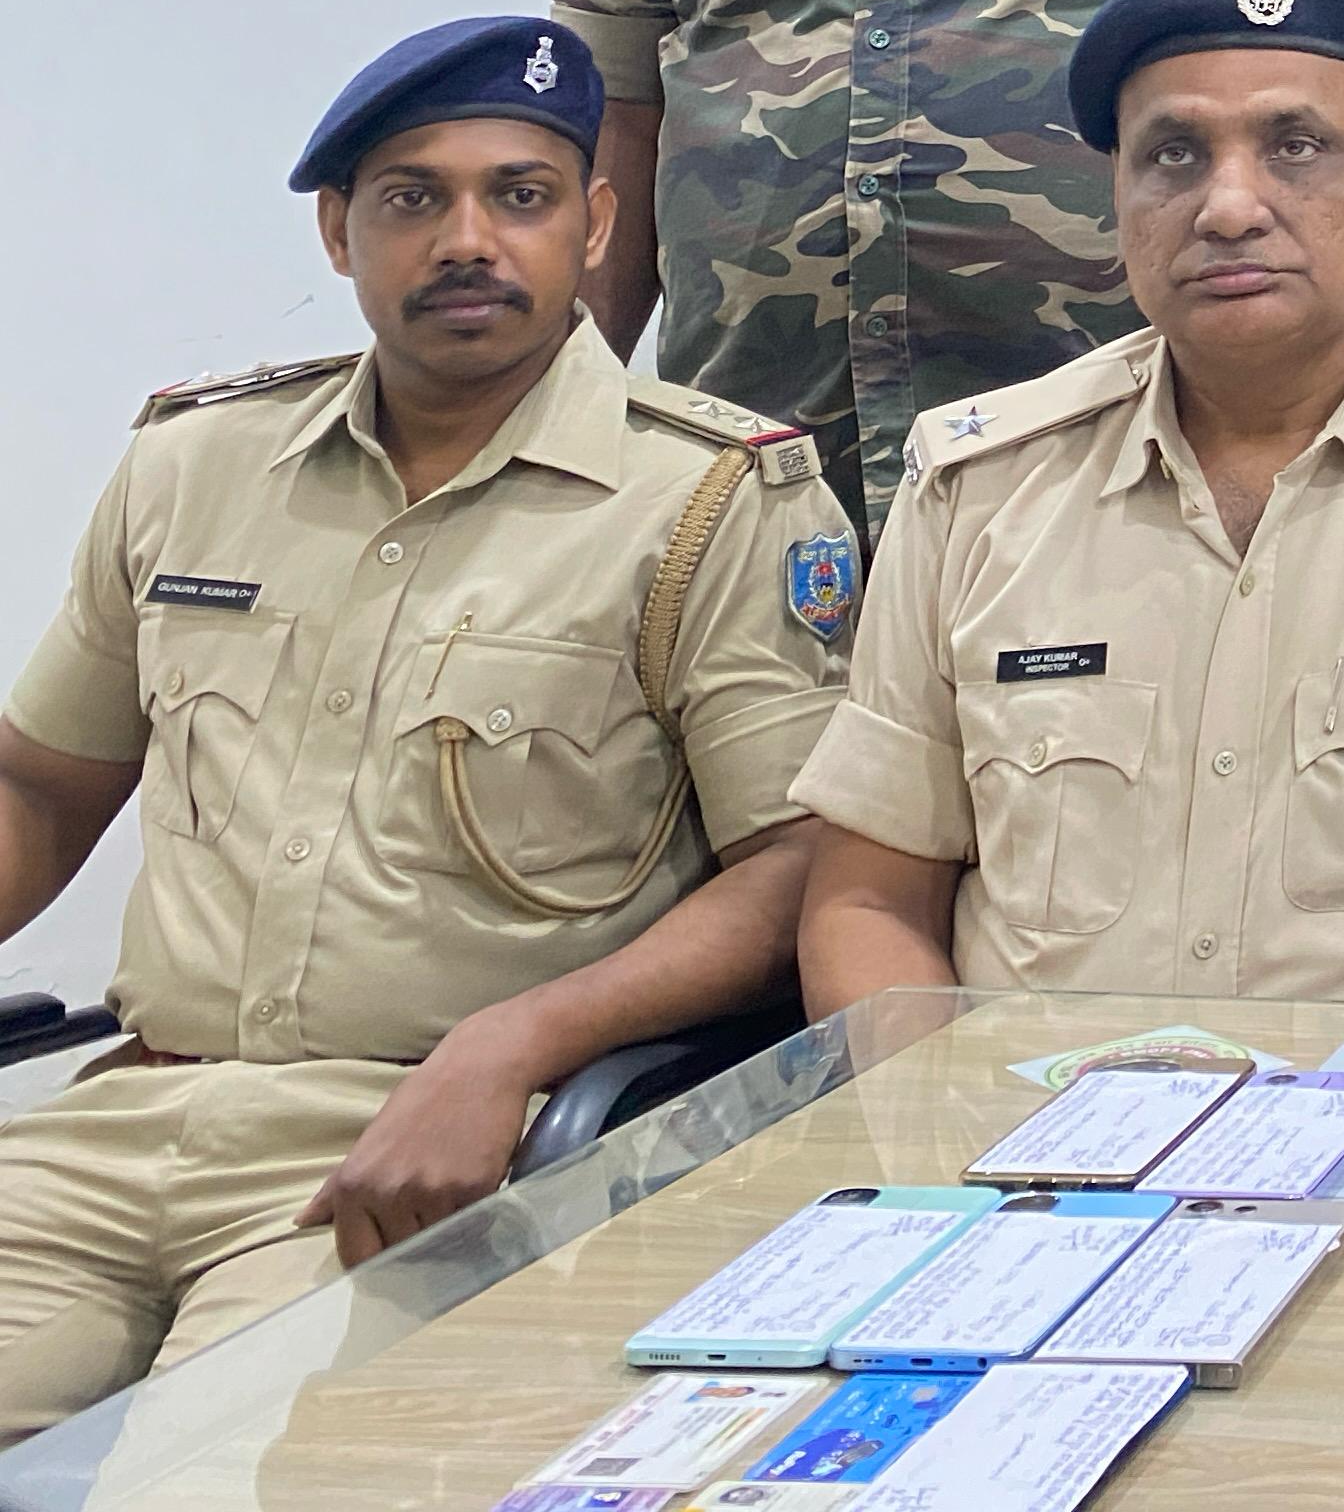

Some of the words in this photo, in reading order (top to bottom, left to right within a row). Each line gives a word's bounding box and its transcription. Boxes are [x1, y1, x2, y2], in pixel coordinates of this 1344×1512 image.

[157, 581, 198, 595] GUNJAN
[200, 586, 238, 599] KUMAR
[1017, 654, 1042, 665] AJAY
[1043, 651, 1079, 663] KUMAR
[1025, 662, 1070, 674] INSPECTOR
